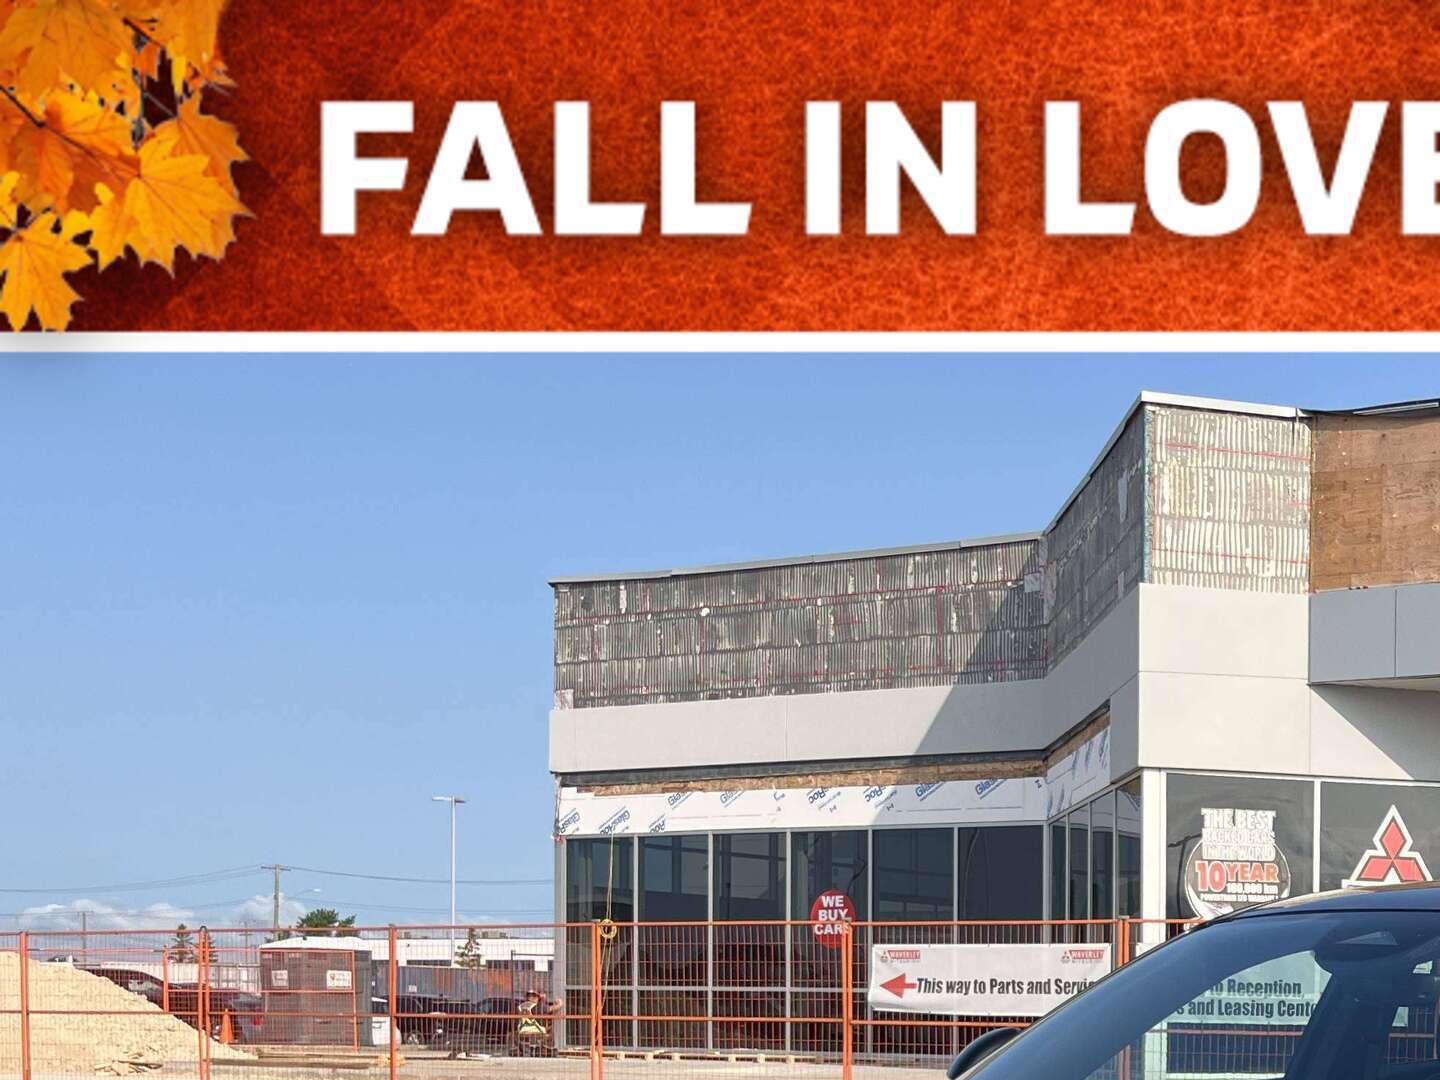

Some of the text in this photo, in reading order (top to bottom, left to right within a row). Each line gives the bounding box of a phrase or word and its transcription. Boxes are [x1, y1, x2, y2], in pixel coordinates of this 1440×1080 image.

[1201, 808, 1276, 829] THE BEST
[1195, 861, 1280, 892] 10 YEAR
[822, 896, 844, 907] WE
[818, 909, 848, 921] BUY
[815, 924, 850, 935] CAR
[917, 978, 943, 994] This
[946, 981, 970, 996] way
[973, 978, 987, 994] to
[990, 978, 1024, 994] Parts
[1027, 978, 1051, 994] and
[1227, 978, 1305, 999] Reception,
[1189, 1000, 1215, 1016] and
[1218, 1000, 1274, 1018] Leasing
